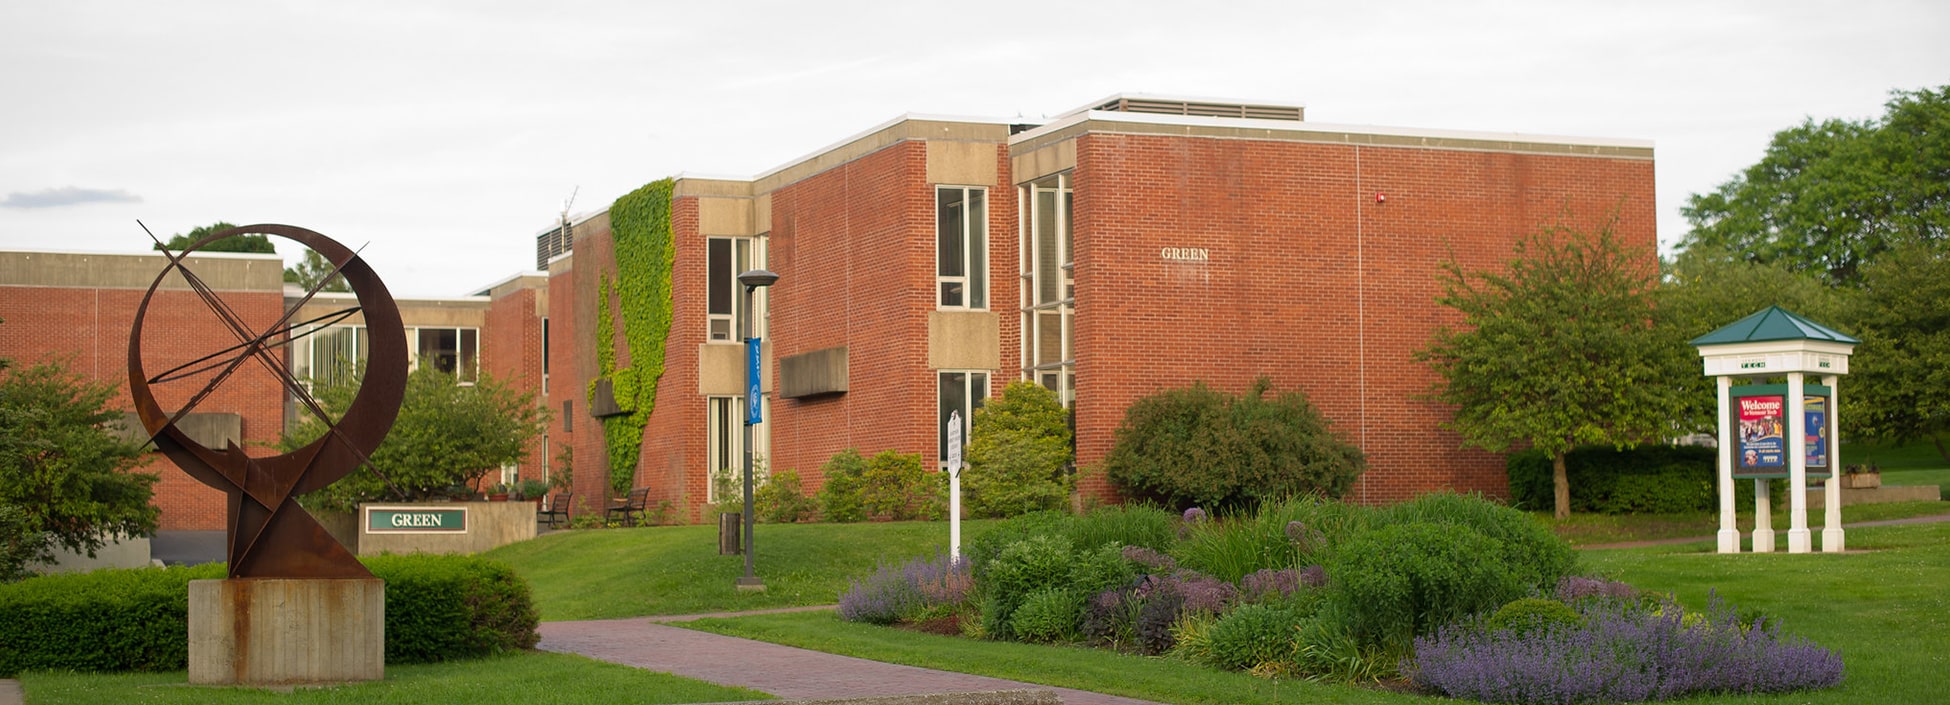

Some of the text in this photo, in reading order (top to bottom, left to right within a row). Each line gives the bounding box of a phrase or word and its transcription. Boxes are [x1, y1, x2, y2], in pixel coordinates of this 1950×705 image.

[1161, 247, 1209, 260] GREEN
[1741, 400, 1780, 410] Welcome
[391, 513, 442, 527] GREEN
